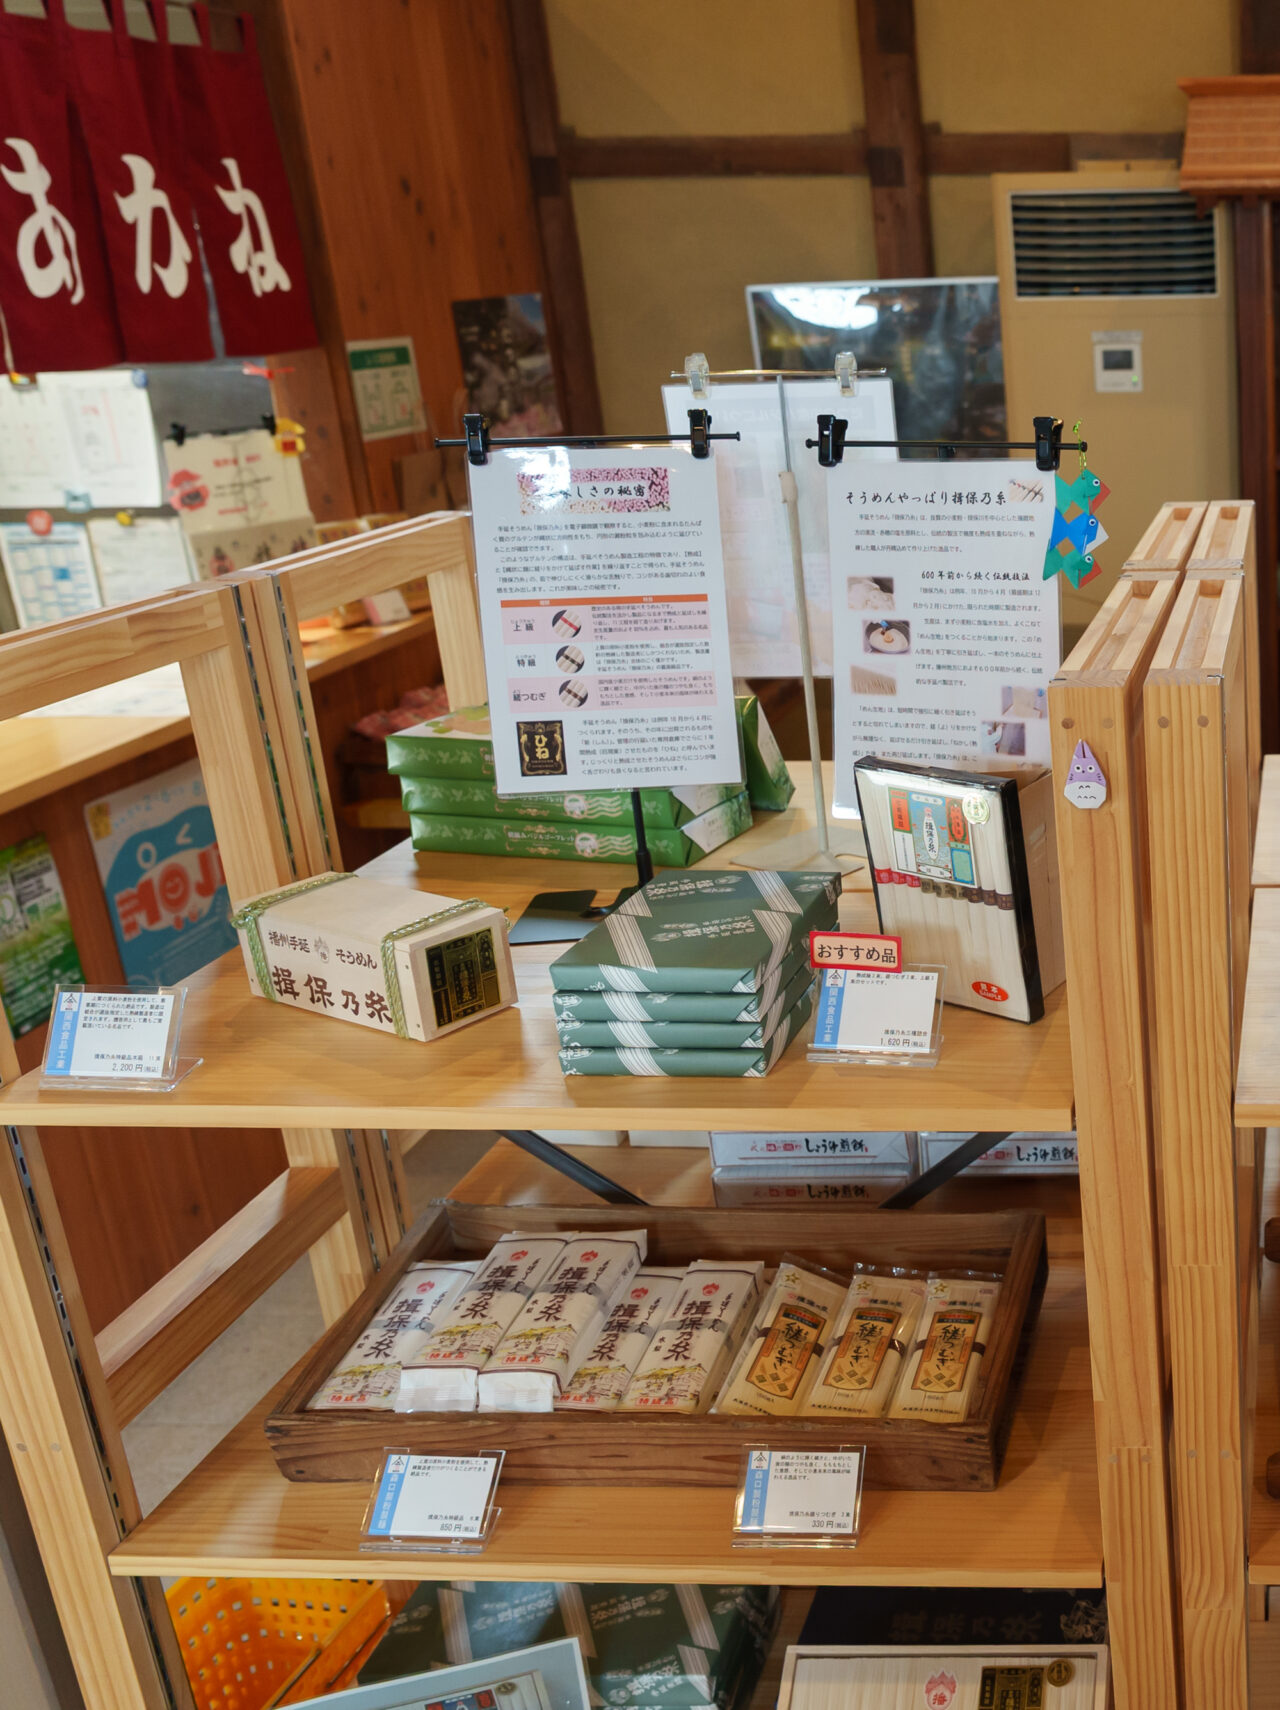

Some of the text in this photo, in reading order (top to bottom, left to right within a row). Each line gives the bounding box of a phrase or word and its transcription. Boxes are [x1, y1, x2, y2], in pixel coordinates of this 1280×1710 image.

[1, 137, 292, 305] あかね
[336, 949, 378, 970] そうめん
[817, 943, 896, 964] おすすめ品
